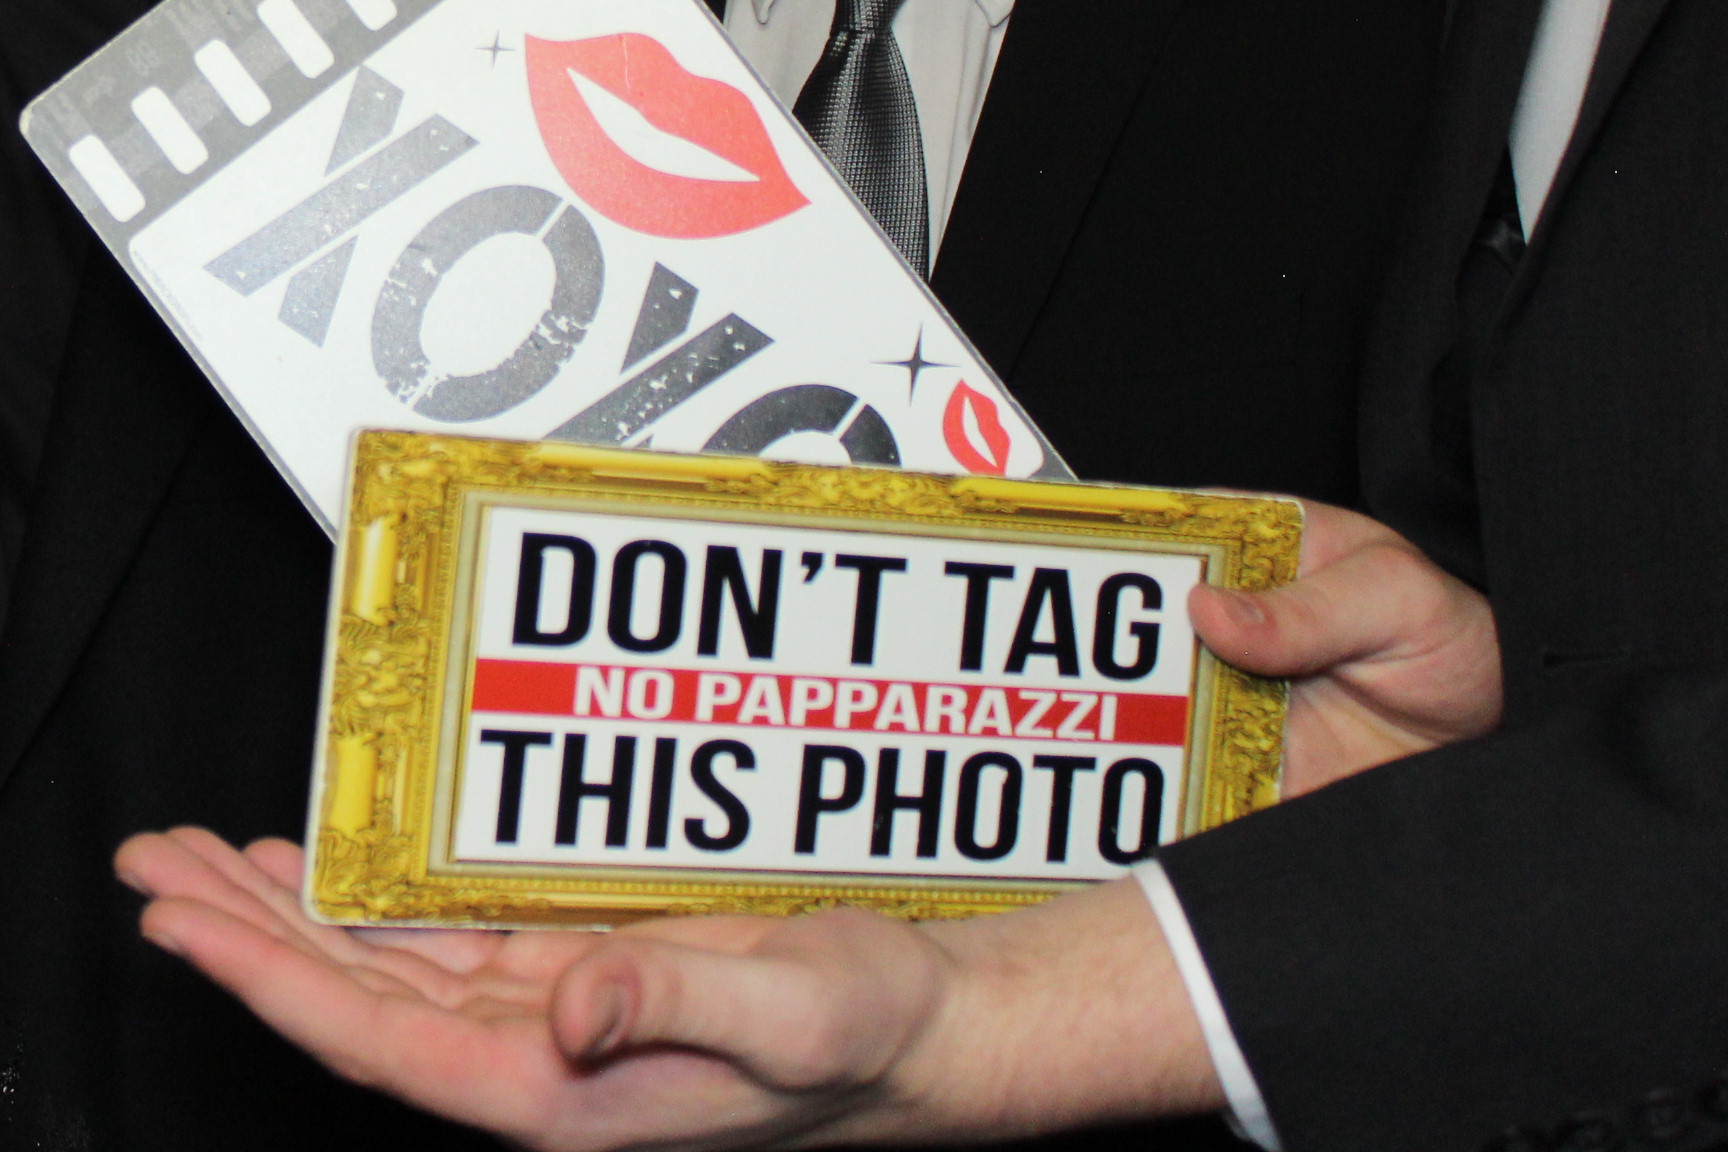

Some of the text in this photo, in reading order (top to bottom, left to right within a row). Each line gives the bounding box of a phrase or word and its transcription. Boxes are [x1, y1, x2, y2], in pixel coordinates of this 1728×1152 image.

[512, 531, 1163, 681] DON'T TAG
[575, 665, 1118, 741] NO PAPPARAZZI
[480, 729, 1164, 865] THIS PHOTO
